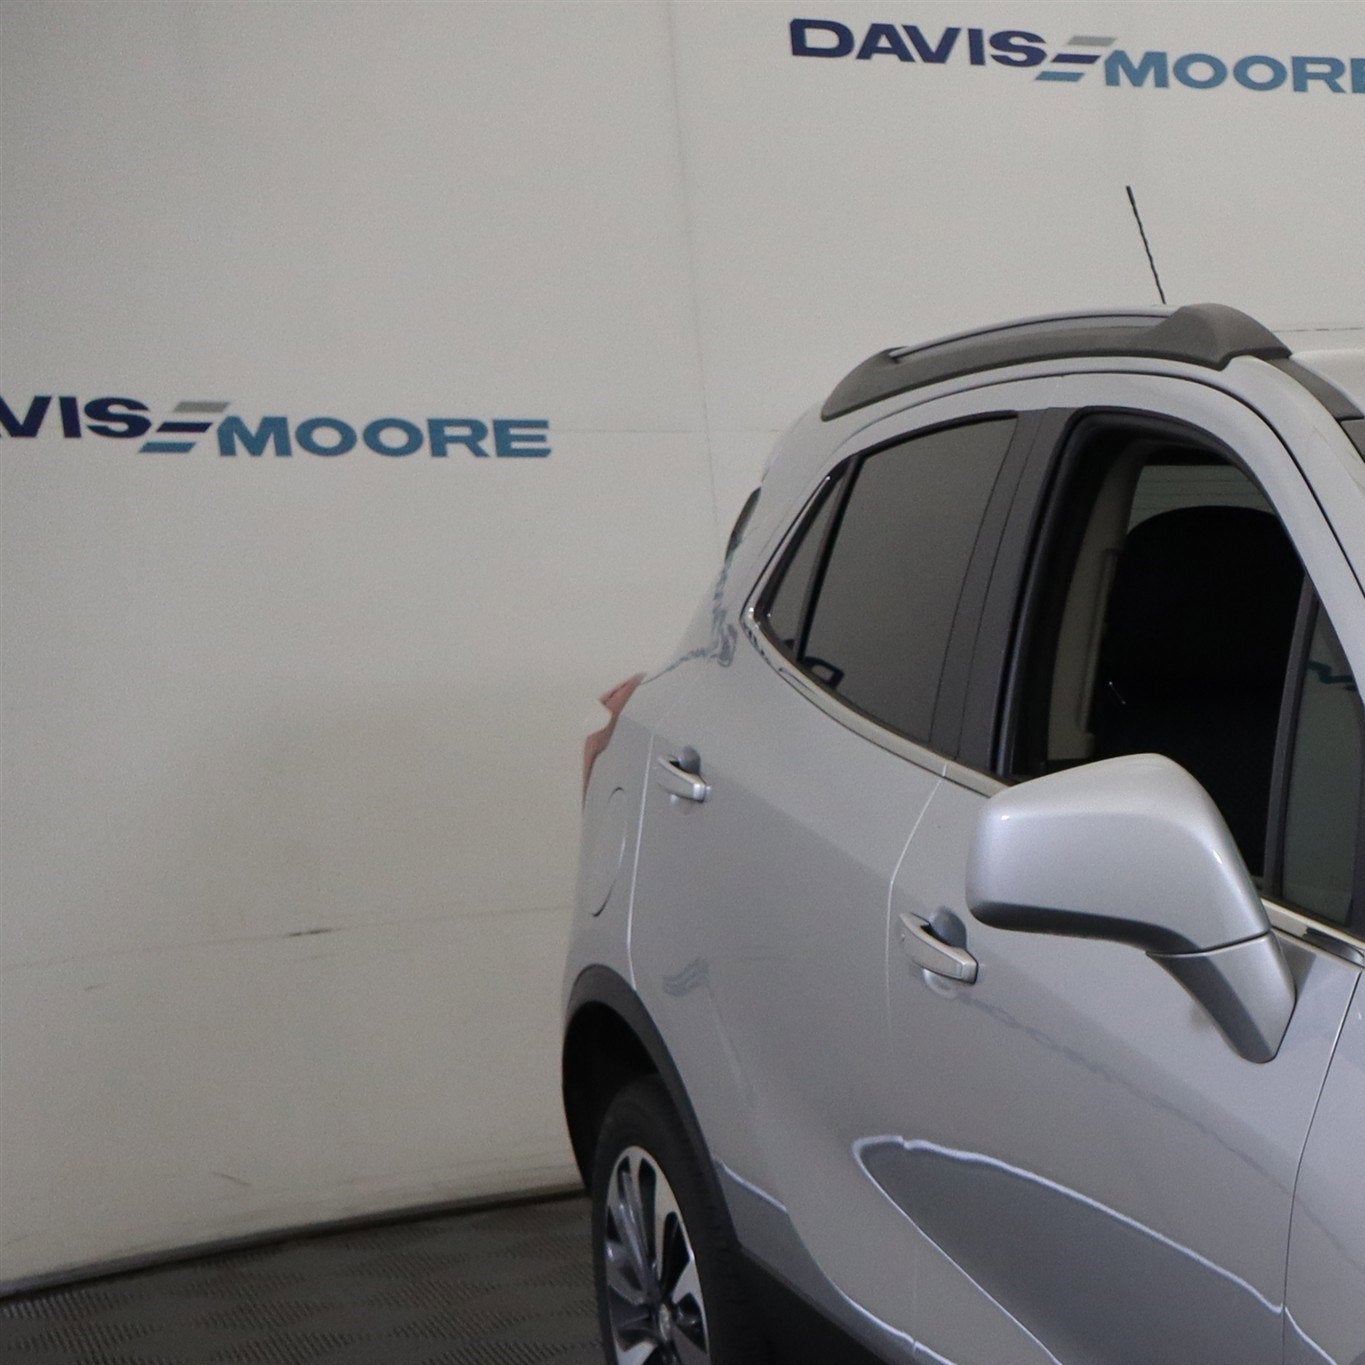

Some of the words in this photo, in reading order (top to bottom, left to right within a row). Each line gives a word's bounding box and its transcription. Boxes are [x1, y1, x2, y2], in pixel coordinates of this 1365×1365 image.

[788, 18, 1046, 67] DAVIS
[0, 395, 151, 439] VIS
[216, 415, 551, 458] MOORE
